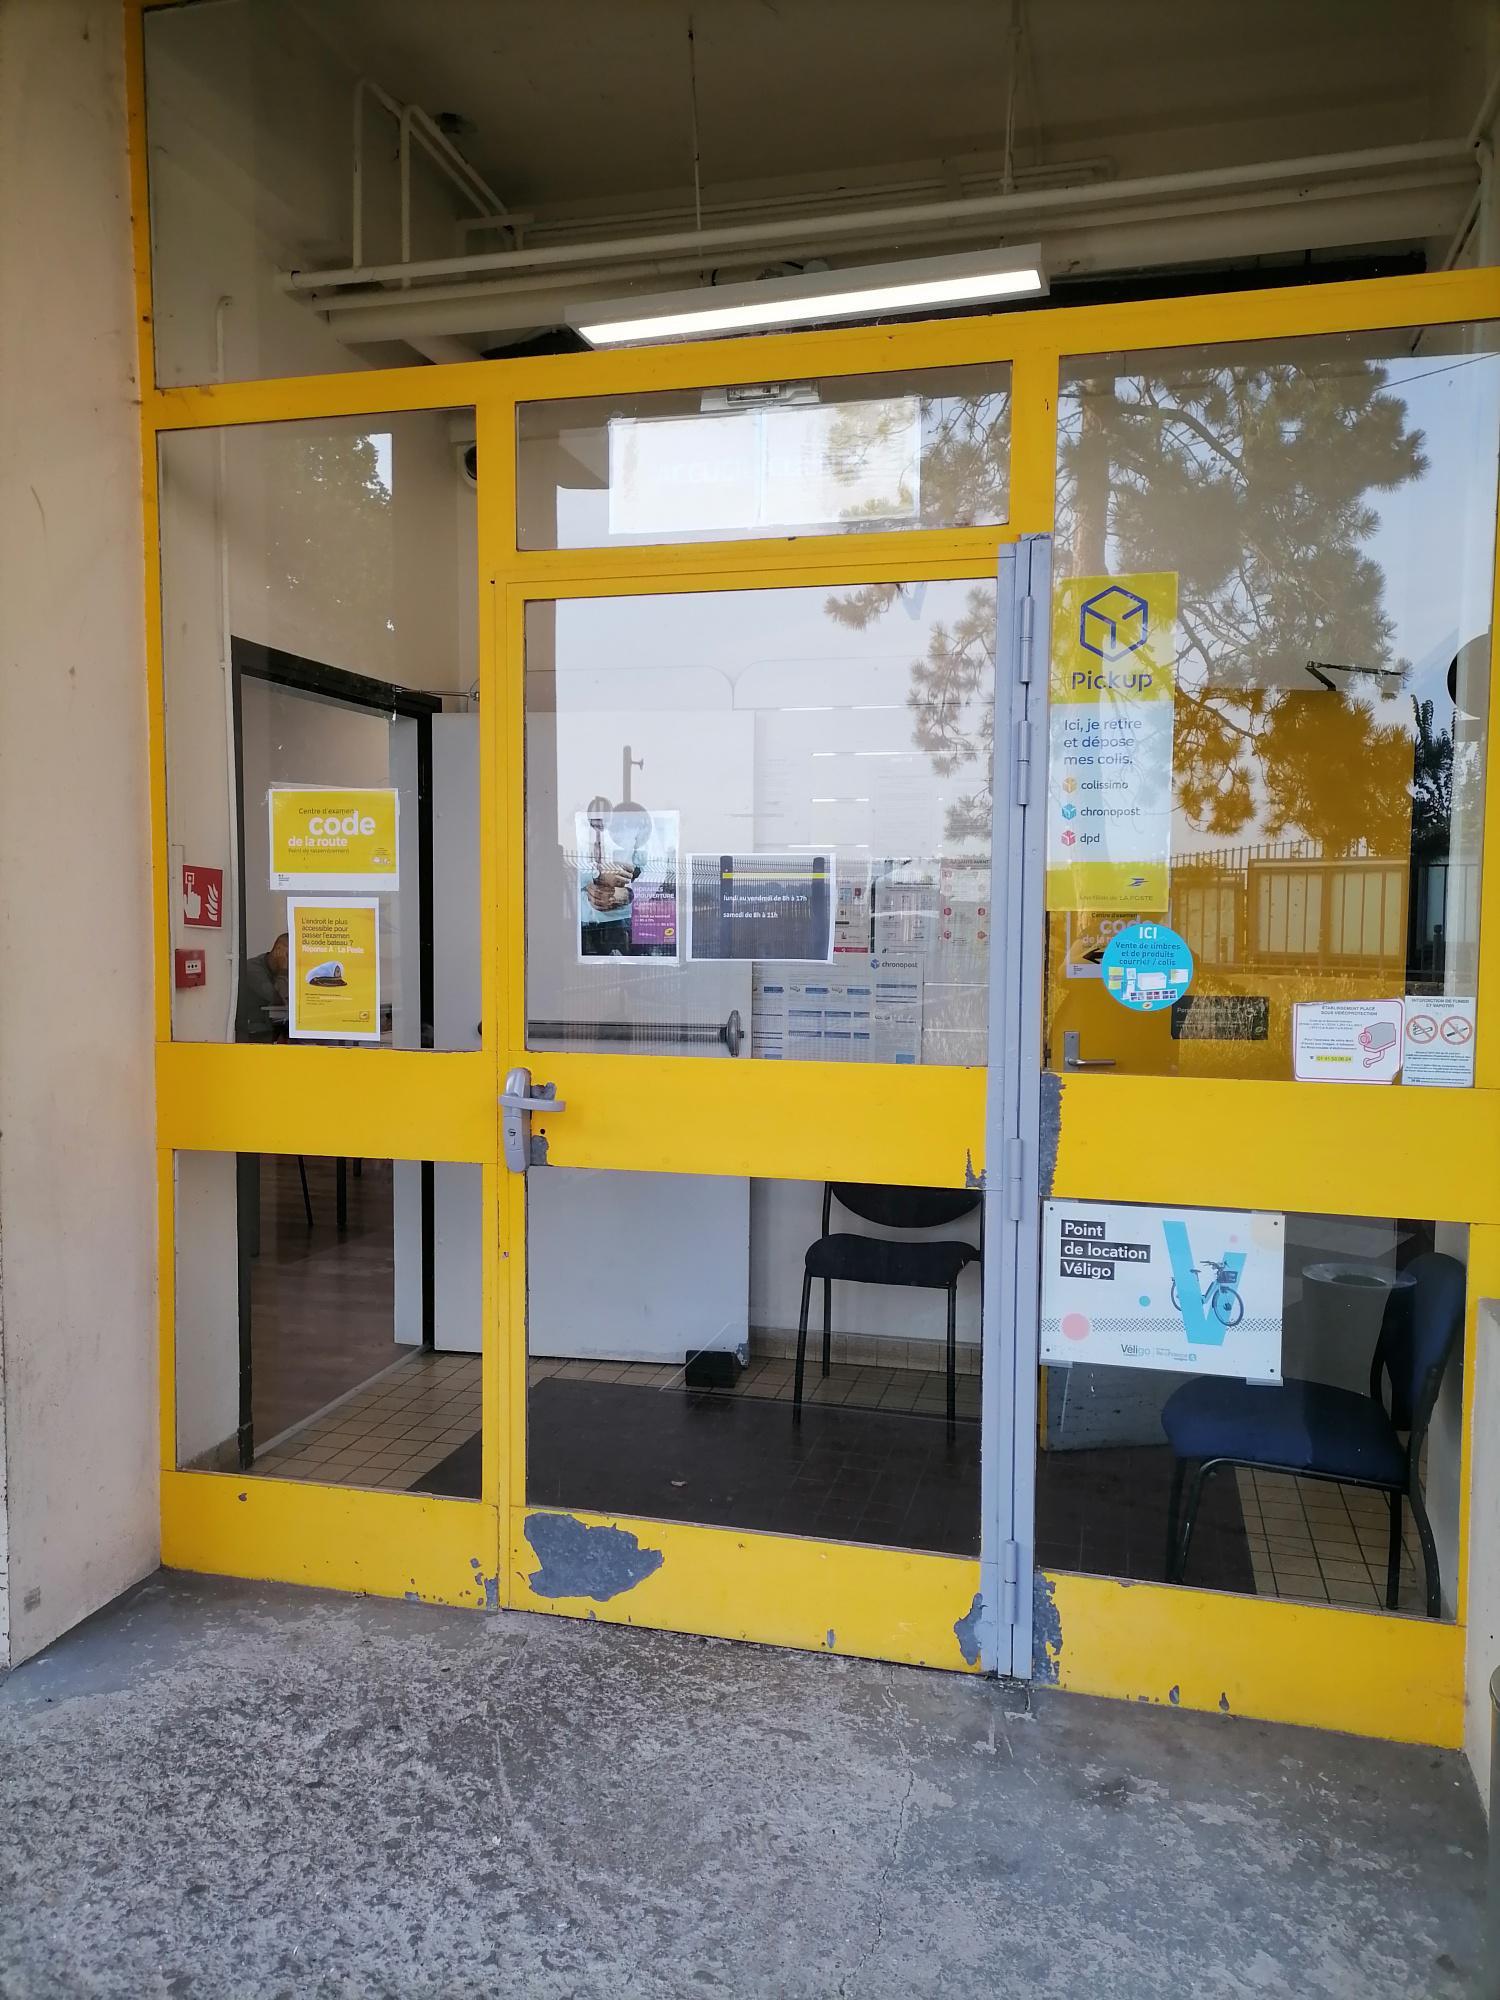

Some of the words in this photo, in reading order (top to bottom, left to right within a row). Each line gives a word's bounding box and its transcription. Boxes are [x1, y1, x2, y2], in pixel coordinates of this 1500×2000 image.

[1071, 671, 1153, 692] Pickup
[1064, 719, 1083, 734] Ici,
[1085, 717, 1100, 733] je
[1103, 718, 1142, 730] retire
[1063, 737, 1079, 748] et
[1081, 735, 1134, 752] dépose
[1063, 755, 1094, 766] mes
[1097, 753, 1133, 766] colis.
[1080, 780, 1129, 791] colissimo
[298, 807, 321, 815] Centre
[1080, 806, 1141, 819] chronopost
[308, 809, 376, 836] code
[288, 836, 303, 847] de
[304, 836, 315, 847] la
[316, 837, 349, 848] route
[1080, 833, 1100, 845] dpd
[1139, 926, 1157, 939] ICI
[1115, 941, 1136, 949] Vente
[1150, 942, 1181, 950] timbres
[1141, 951, 1175, 959] produits
[882, 961, 918, 969] chronopost
[1160, 958, 1176, 966] colis
[1064, 1222, 1103, 1237] Point
[1064, 1242, 1084, 1256] de
[1088, 1243, 1148, 1260] location
[1063, 1262, 1112, 1279] Véligo
[1120, 1343, 1151, 1356] Véligo
